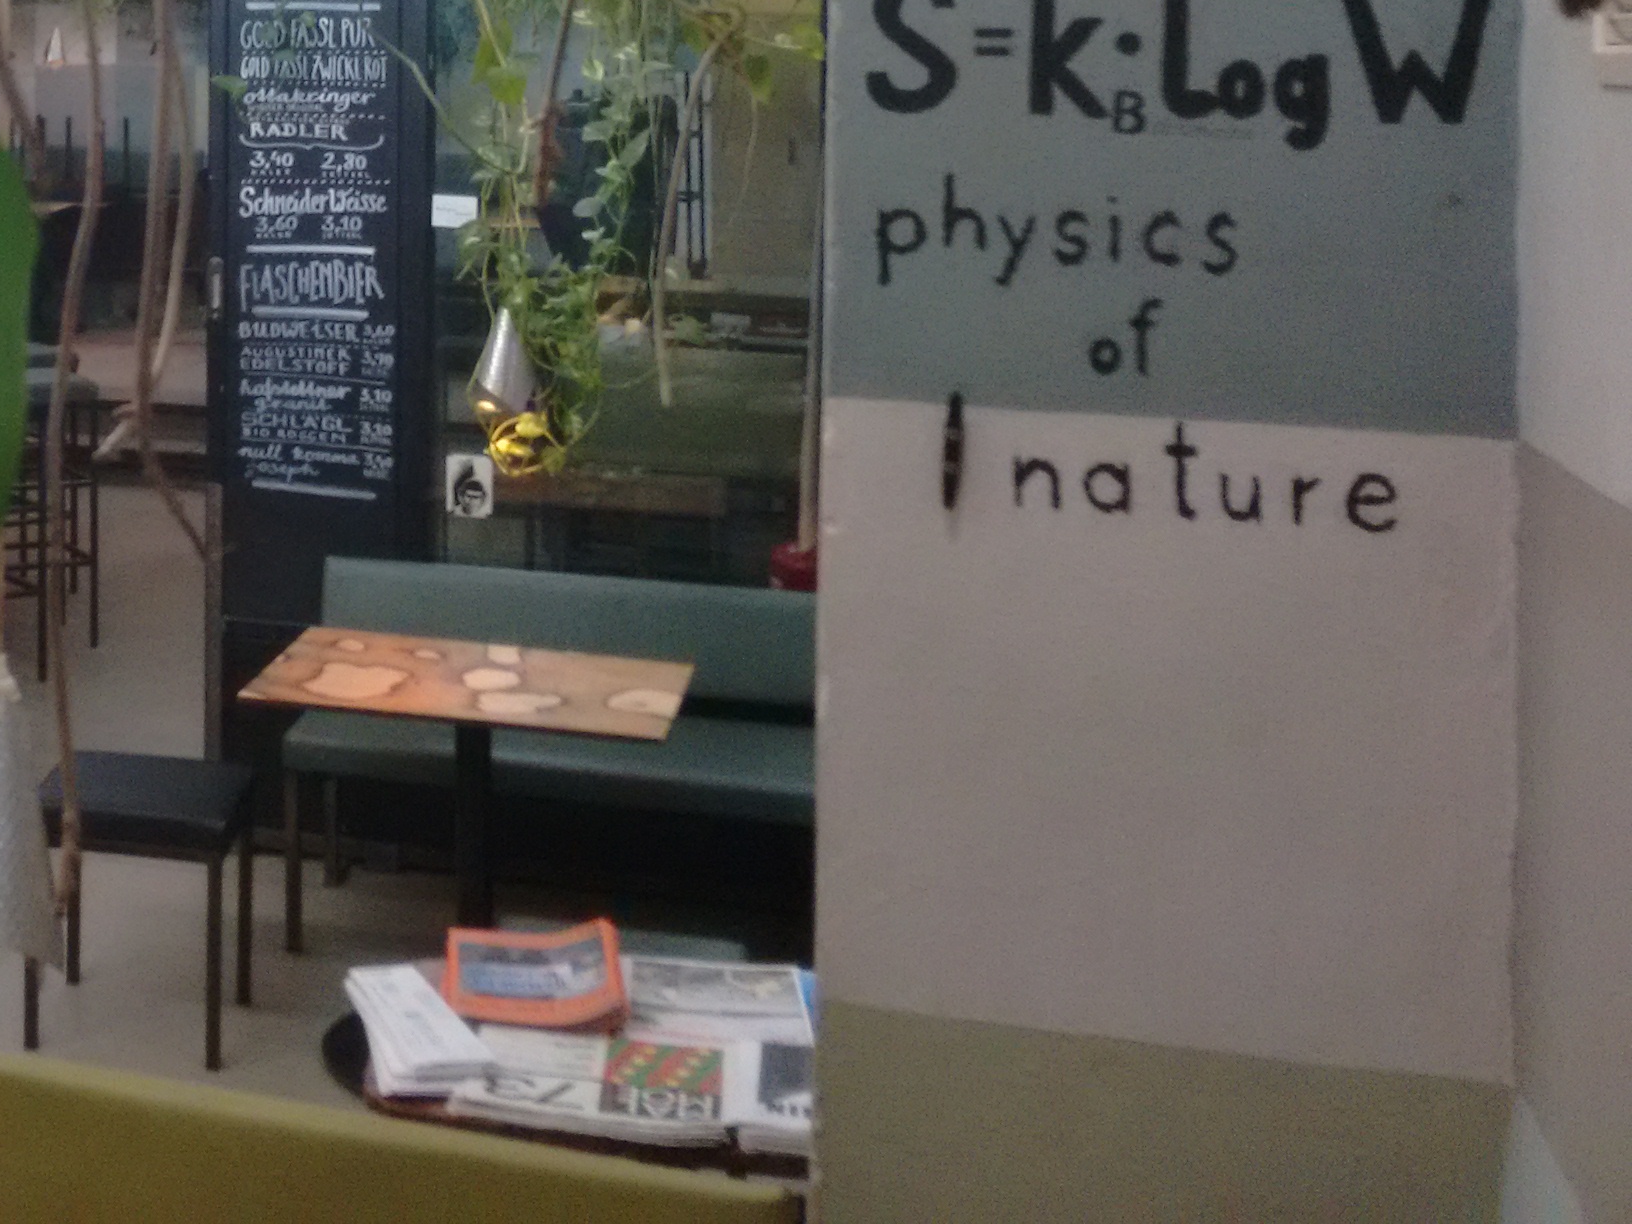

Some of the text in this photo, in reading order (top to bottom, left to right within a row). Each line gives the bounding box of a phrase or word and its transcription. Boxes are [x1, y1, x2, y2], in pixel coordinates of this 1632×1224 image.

[249, 121, 349, 142] RADLER
[249, 149, 368, 173] 3,40 2,80
[255, 215, 363, 233] 3,60 3,10
[873, 174, 1240, 287] physics
[239, 259, 385, 312] FLASCHENBIER
[1088, 297, 1163, 376] of
